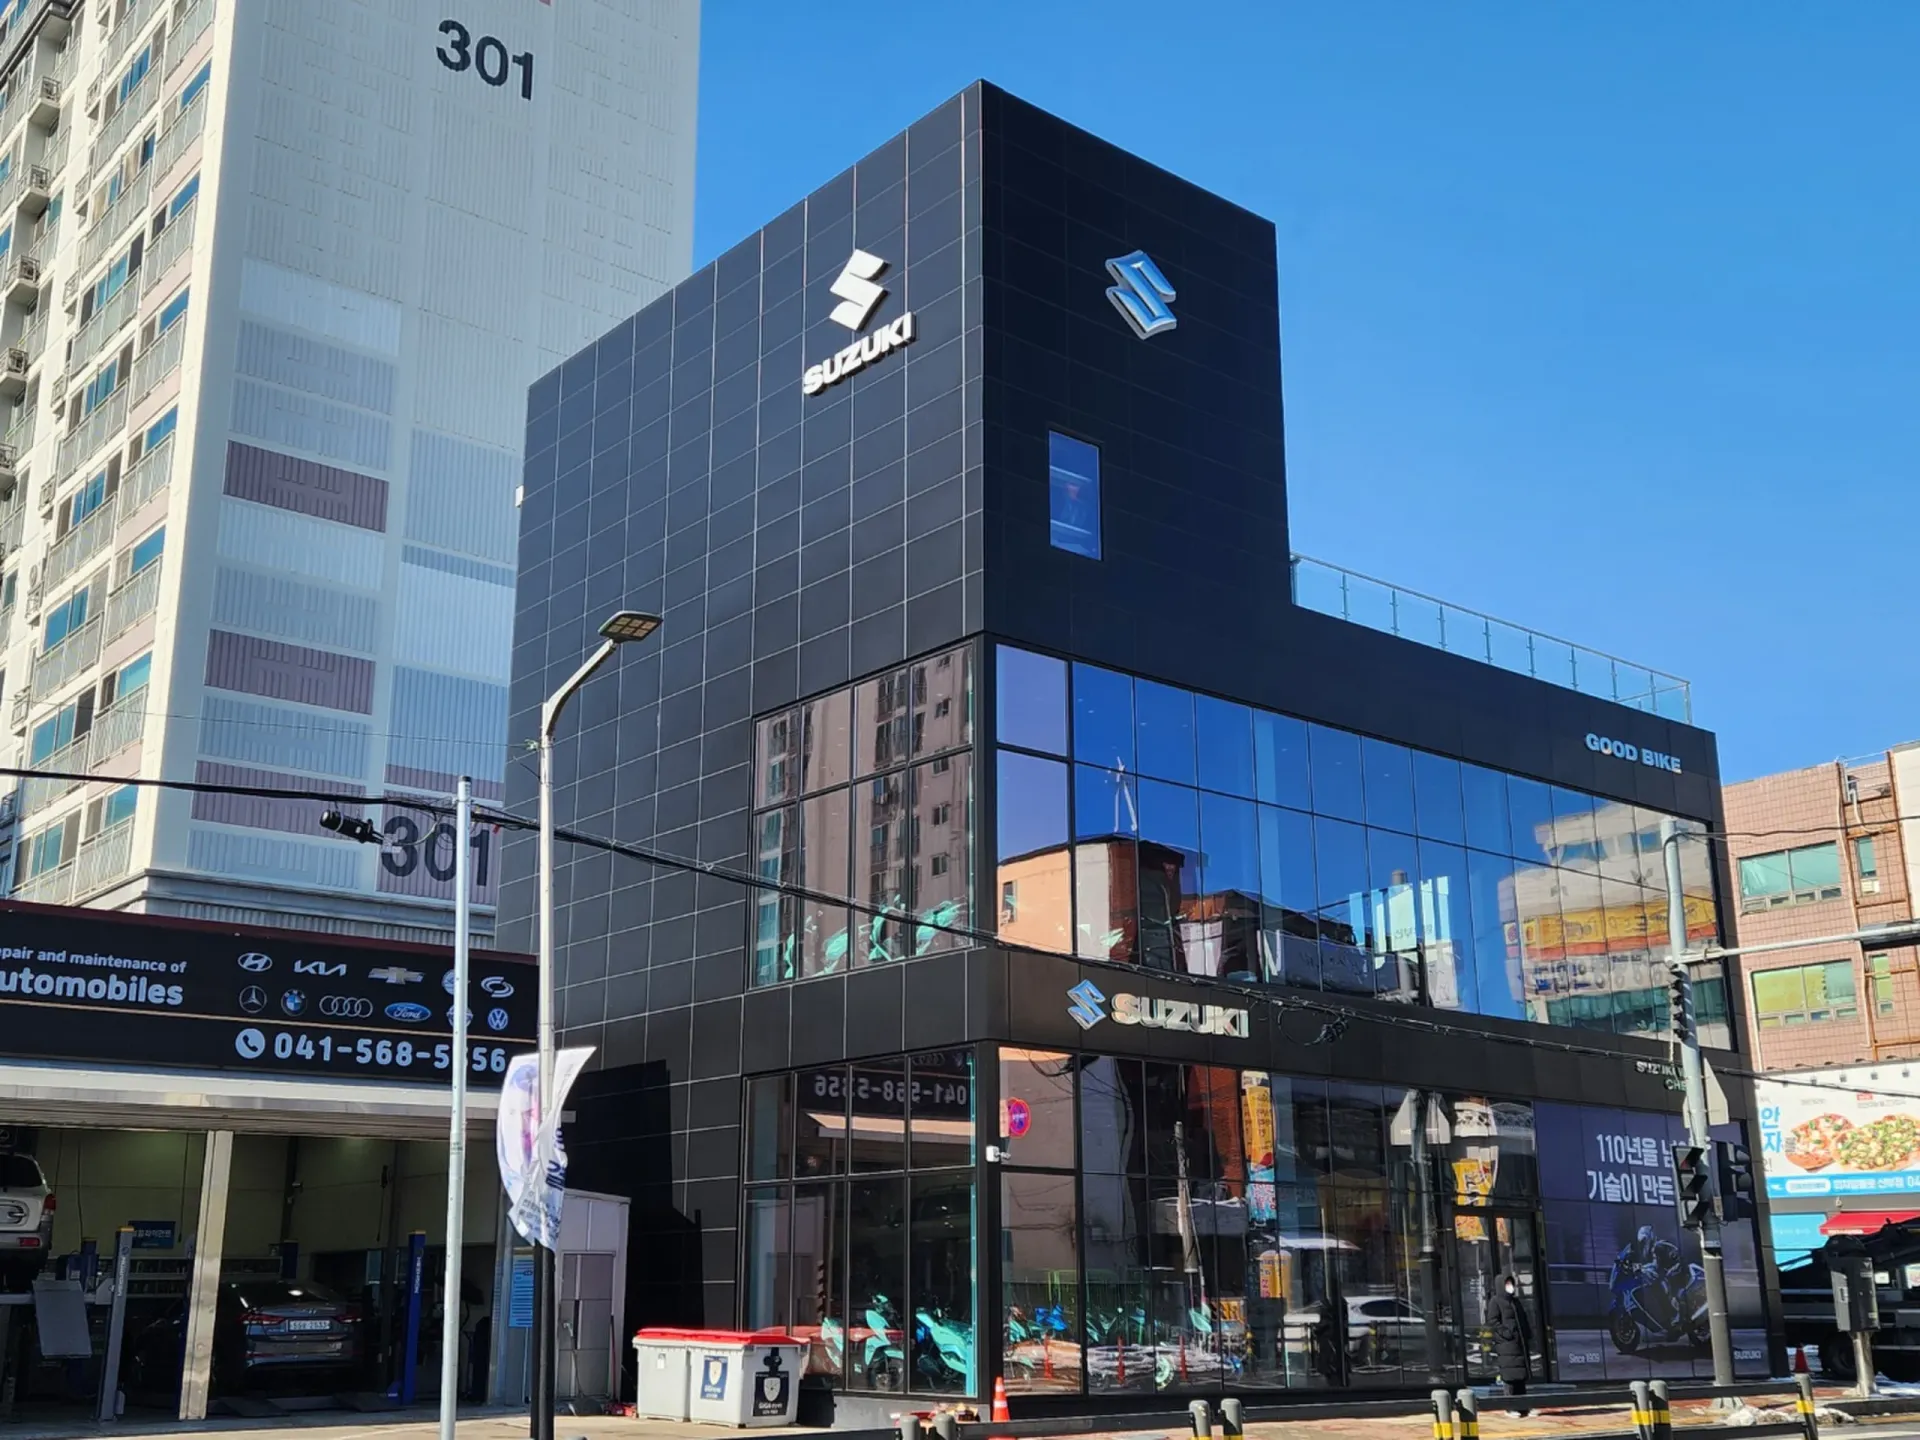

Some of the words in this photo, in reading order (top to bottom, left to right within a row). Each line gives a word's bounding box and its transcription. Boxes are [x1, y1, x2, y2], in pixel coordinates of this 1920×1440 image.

[436, 19, 533, 101] 301
[802, 312, 918, 396] SUZUKI
[1585, 733, 1638, 762] GOOD
[1641, 748, 1682, 775] BIKE
[381, 816, 490, 887] 301
[0, 946, 34, 960] pair
[37, 950, 66, 964] and
[69, 953, 167, 972] maintenance
[170, 961, 188, 974] of
[394, 1004, 421, 1020] Ford
[1112, 993, 1249, 1038] SUZUKI
[274, 1032, 506, 1073] 041-568-556
[1596, 1134, 1659, 1168] 110년을
[1586, 1170, 1639, 1204] 기술이
[1641, 1174, 1676, 1207] 만든
